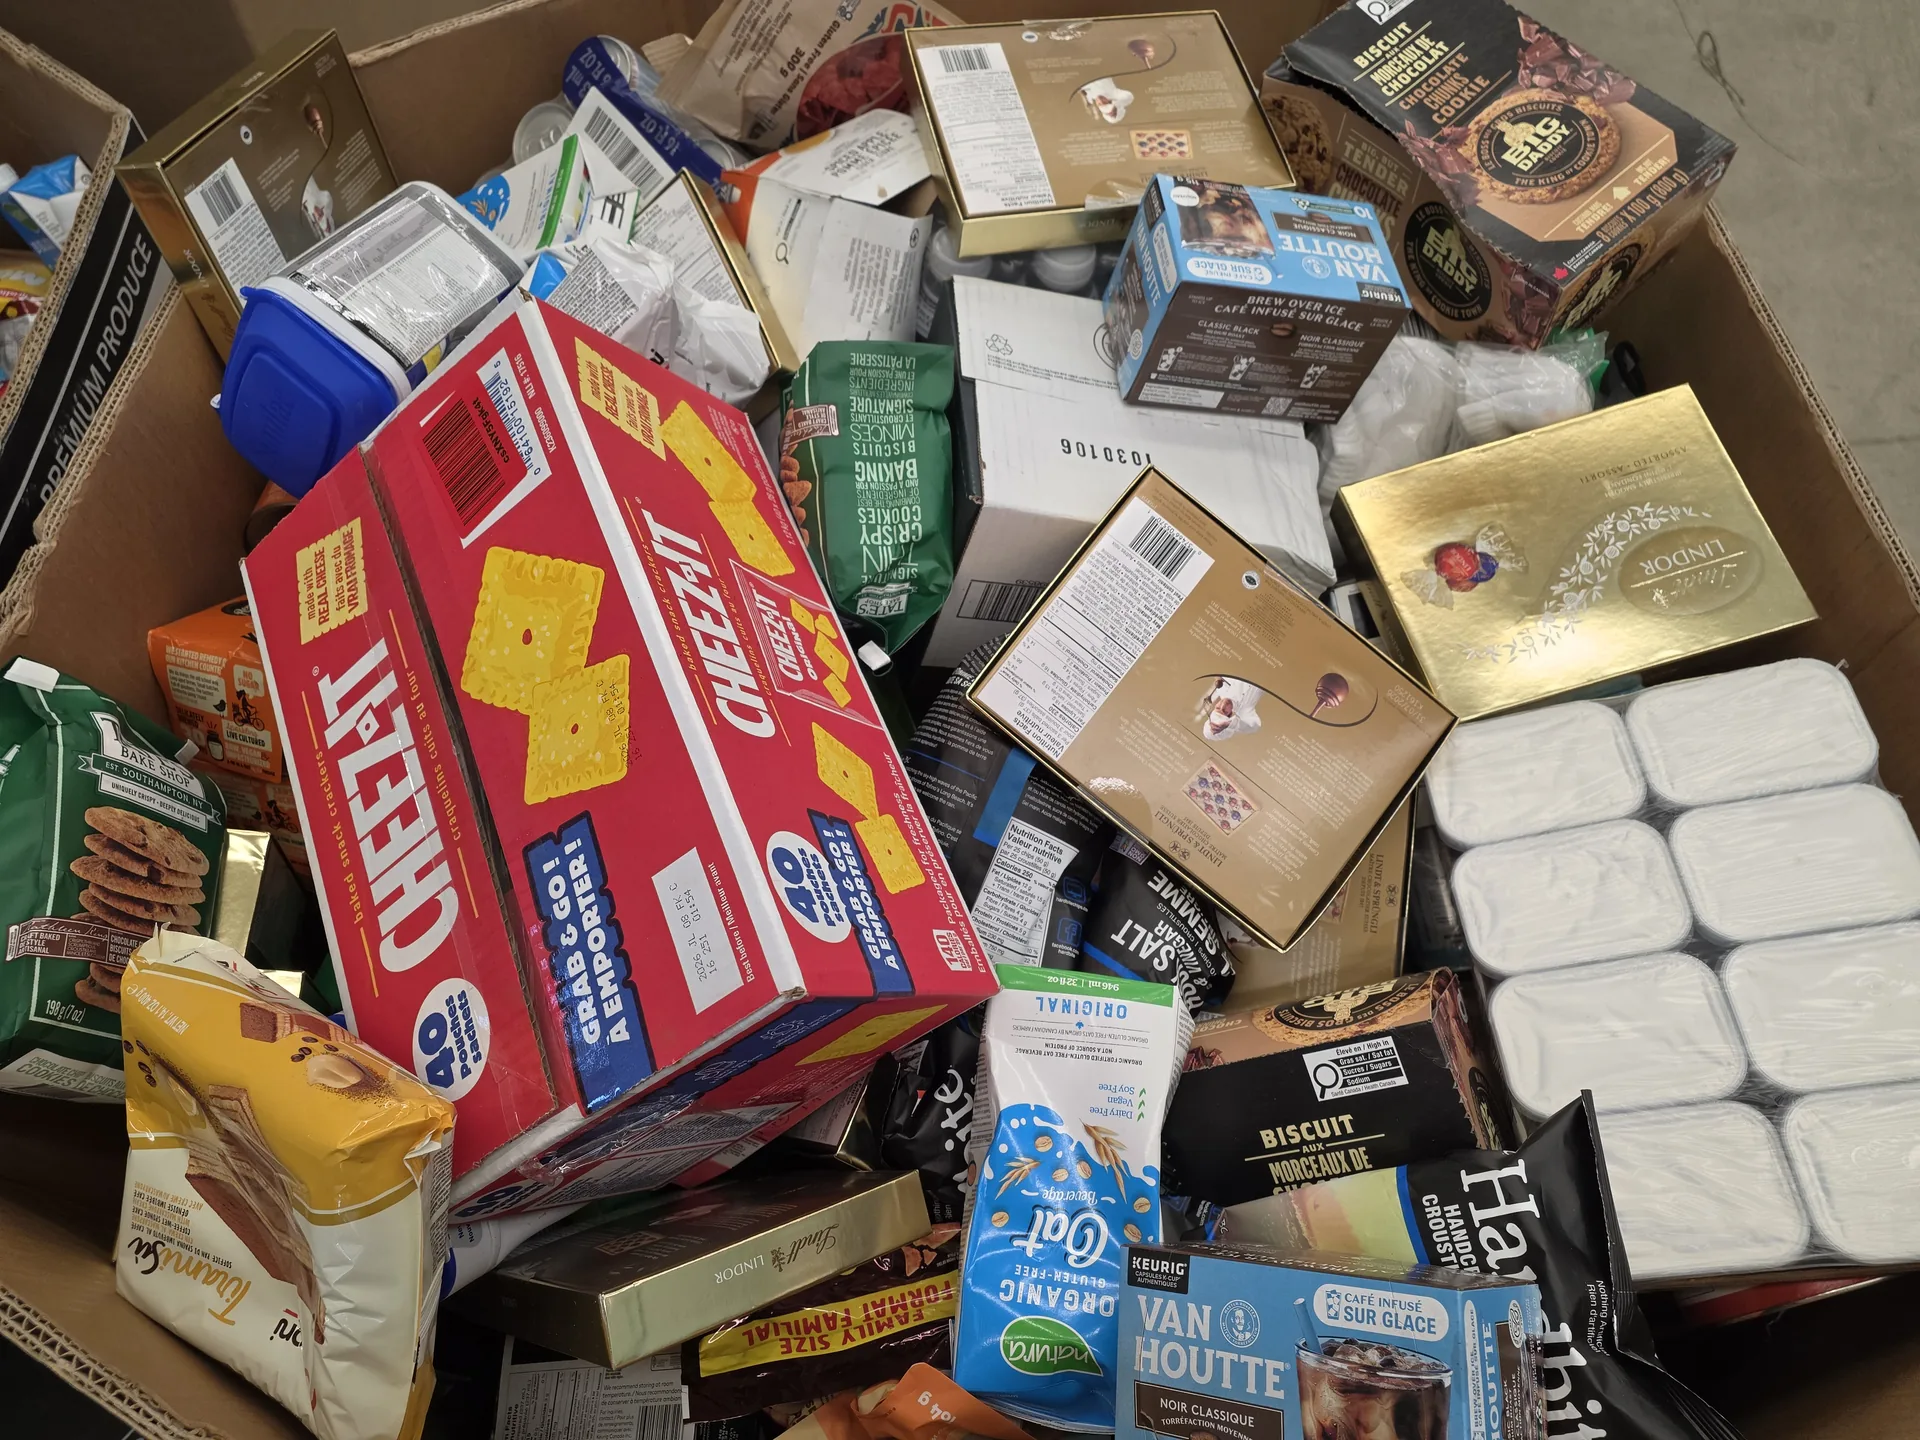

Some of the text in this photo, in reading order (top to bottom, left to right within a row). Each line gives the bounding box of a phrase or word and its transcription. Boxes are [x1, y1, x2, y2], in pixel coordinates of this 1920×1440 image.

[1353, 22, 1412, 68] BISCUIT
[780, 46, 805, 79] 300 g
[1381, 41, 1449, 96] CHOCOLAT
[1399, 53, 1468, 110] CHOCOLATE
[1423, 72, 1469, 110] CHUNKS
[1432, 76, 1490, 124] COOKIE
[1501, 117, 1561, 166] BIG
[1516, 125, 1572, 171] DADDY
[1343, 142, 1410, 196] TENDER
[1335, 164, 1402, 218] CHOCOLATE
[1353, 205, 1373, 220] 10
[1278, 234, 1384, 265] HOUTTE
[183, 248, 209, 288] LINDOR
[1336, 260, 1390, 283] VAN
[1247, 296, 1346, 316] BREW OVER ICE
[1361, 290, 1401, 302] KEURIG
[1198, 320, 1260, 335] CLASSIC BLACK
[1215, 303, 1363, 332] CAFÉ INFUSÉ SUR GLACE
[1301, 334, 1365, 348] NOIR CLASSIQUE
[40, 234, 152, 504] PREMIUM PRODUCE
[851, 353, 915, 369] LA PÂTISSERIE
[600, 364, 619, 420] REAL CHEESE
[850, 396, 913, 413] SIGNATURE
[850, 423, 914, 442] MINCES
[854, 440, 915, 456] BISCUITS
[1060, 438, 1151, 466] 1030106
[1633, 446, 1687, 468] ASSORTED
[855, 459, 918, 482] BAKING
[870, 481, 897, 489] PASSION
[1580, 465, 1624, 484] ASSORTI
[856, 482, 868, 490] FOR
[857, 489, 906, 499] INGREDIENTS
[858, 505, 922, 524] COOKIES
[860, 522, 923, 545] CRISPY
[343, 527, 360, 614] VRAI FROMAGE
[863, 543, 918, 573] THIN
[1639, 539, 1726, 576] LINDOR
[312, 547, 330, 625] REAL CHEESE
[642, 544, 697, 671] baked snack crackers
[227, 731, 266, 747] LIVE CULTURED
[121, 746, 191, 788] BAKE SHOP
[406, 668, 463, 842] craquelins cuits au four
[111, 782, 201, 824] UNIQUELY CRISPY DEEPLY DELICIOUS
[893, 793, 920, 846] freshness
[315, 749, 364, 926] baked snack crackers
[1007, 832, 1063, 865] Valeur nutritive
[1010, 824, 1064, 856] Nutrition Facts
[918, 849, 930, 866] for
[771, 846, 819, 924] 40
[799, 847, 836, 927] pouches
[811, 853, 844, 923] sachets
[924, 869, 956, 924] Packaged
[681, 914, 691, 929] 08
[708, 862, 755, 983] Best before Meilleur avant
[1157, 902, 1196, 943] CROUSTILLES
[688, 933, 697, 947] JL
[938, 935, 958, 965] 140
[1110, 918, 1176, 972] SALT
[1154, 920, 1203, 974] VINEGAR
[693, 953, 707, 982] 2026
[1048, 975, 1058, 983] oz
[1067, 977, 1078, 987] 32
[1088, 979, 1098, 989] ml
[1100, 981, 1120, 992] 946
[46, 999, 59, 1016] 198
[72, 1006, 86, 1023] oz)
[1036, 996, 1127, 1019] ORIGINAL
[446, 995, 472, 1080] pouches
[458, 989, 482, 1065] sachets
[418, 1012, 455, 1090] 40
[1336, 1045, 1354, 1056] Élevé
[1366, 1040, 1381, 1051] High
[1346, 1075, 1371, 1086] Sodium
[1089, 1106, 1133, 1120] Dairy Free
[1107, 1095, 1133, 1107] Vegan
[1259, 1114, 1354, 1149] BISCUIT
[1302, 1142, 1325, 1153] AUX
[1268, 1147, 1373, 1184] MORCEAUX DE
[176, 1242, 193, 1254] SPAGNA
[1010, 1205, 1109, 1268] Oat
[201, 1251, 210, 1260] PAN
[212, 1255, 232, 1268] SOFFICE
[714, 1223, 840, 1284] Lindt LINDOR
[1132, 1256, 1187, 1275] KEURIG
[1014, 1264, 1106, 1288] GLUTEN-FREE
[1137, 1277, 1178, 1289] AUTHENTIQUES
[742, 1280, 954, 1346] FORMAT FAMILIAL
[1000, 1280, 1115, 1317] ORGANIC
[1344, 1292, 1423, 1313] CAFÉ INFUSÉ
[1597, 1280, 1608, 1318] Nothing
[780, 1308, 925, 1355] FAMILY SIZE
[1137, 1295, 1211, 1341] VAN
[1344, 1306, 1437, 1335] SUR GLACE
[1008, 1341, 1089, 1364] natura
[1134, 1336, 1285, 1400] HOUTTE
[611, 1383, 638, 1391] recommend
[639, 1382, 655, 1390] storing
[1160, 1398, 1255, 1428] NOIR CLASSIQUE
